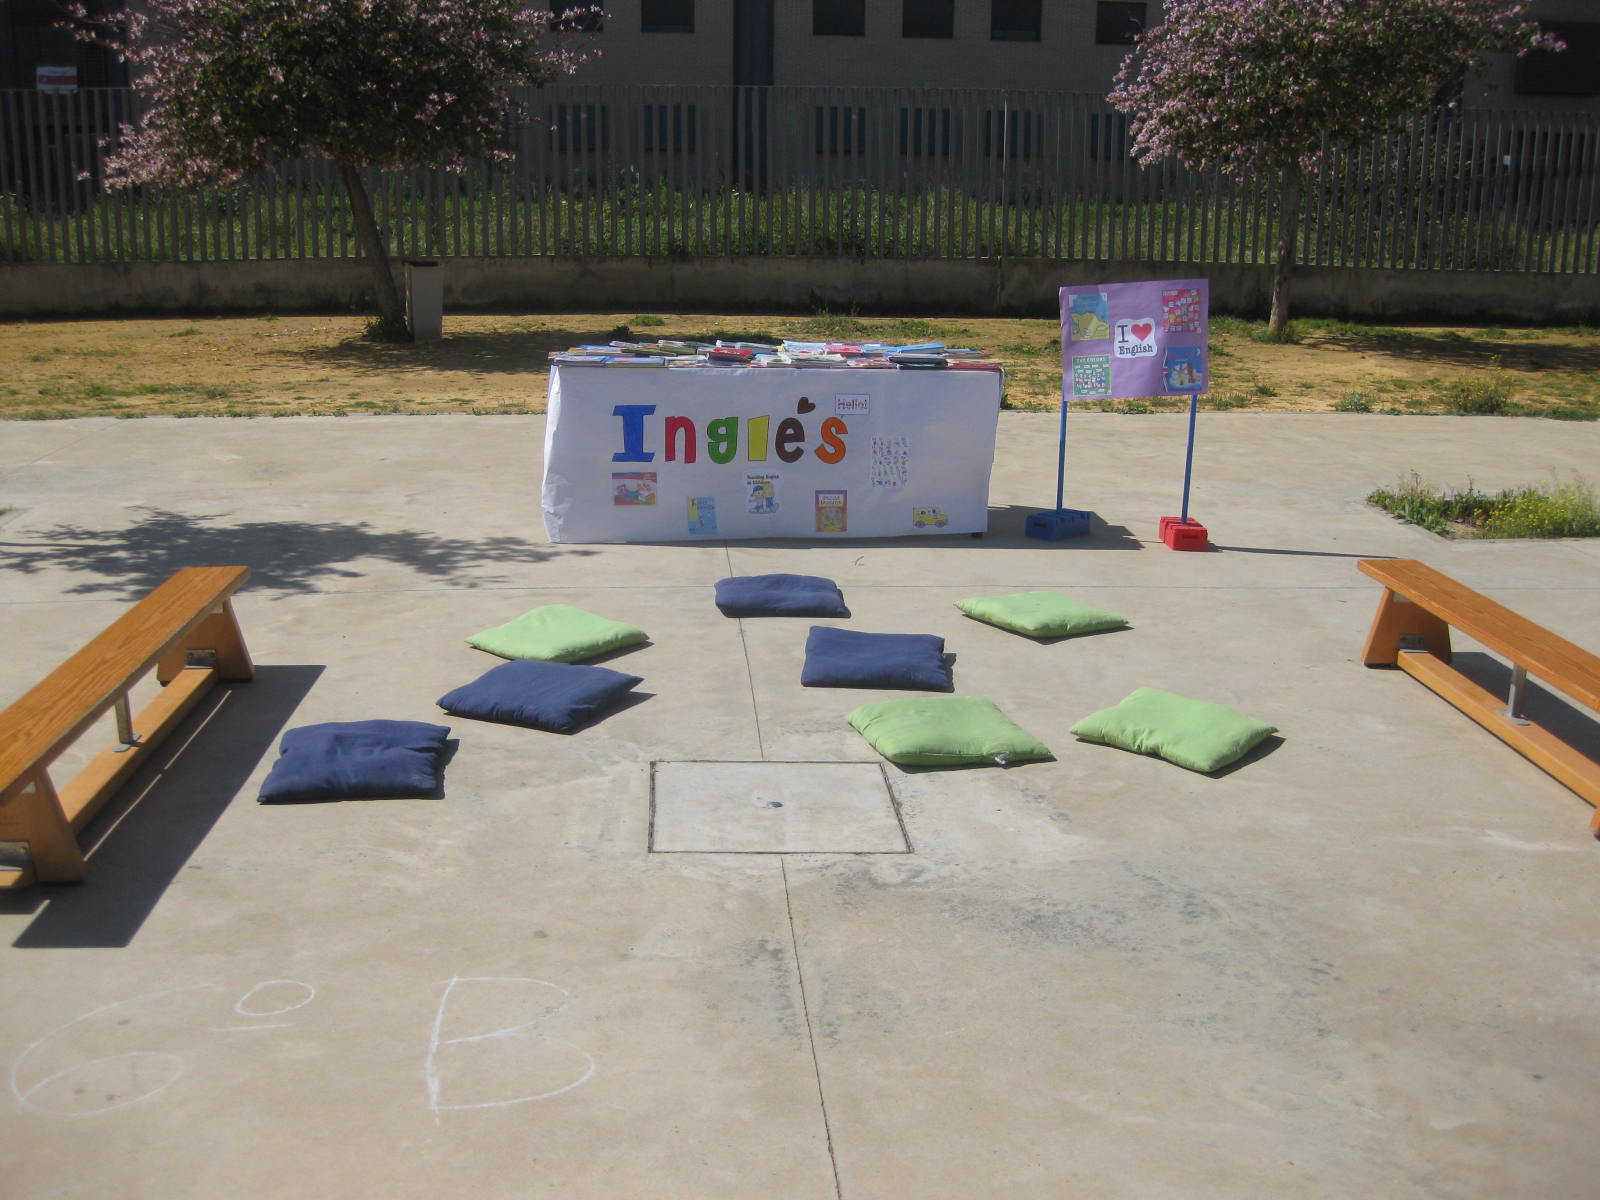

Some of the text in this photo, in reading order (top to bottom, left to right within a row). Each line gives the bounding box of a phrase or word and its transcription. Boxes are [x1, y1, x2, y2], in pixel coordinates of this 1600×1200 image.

[1117, 324, 1128, 343] I
[1118, 344, 1154, 357] English
[837, 399, 867, 410] Hello!
[423, 974, 596, 1128] B
